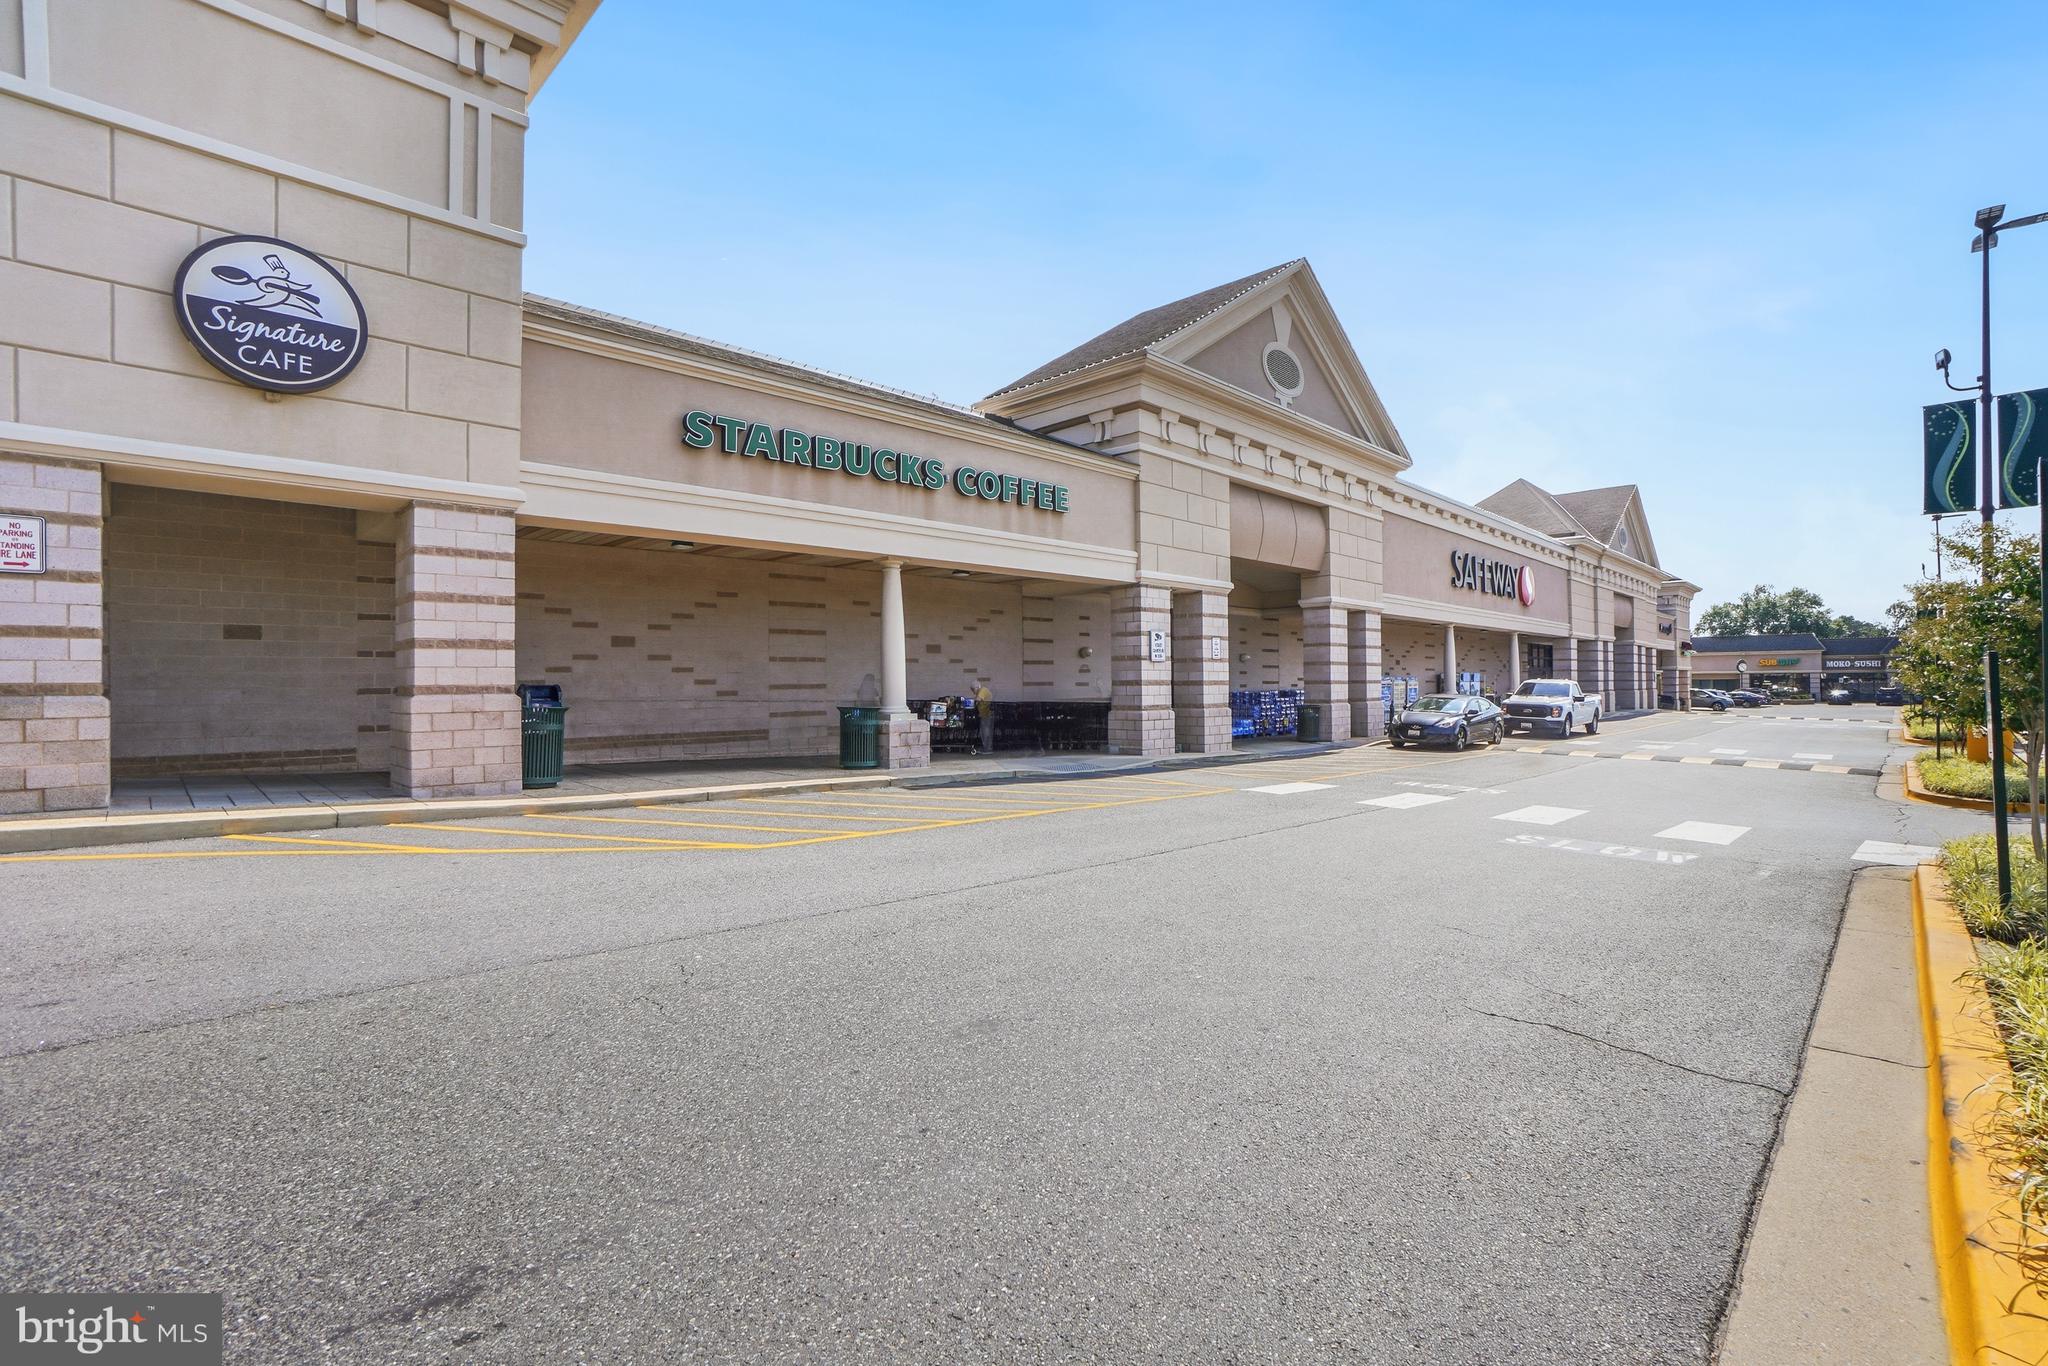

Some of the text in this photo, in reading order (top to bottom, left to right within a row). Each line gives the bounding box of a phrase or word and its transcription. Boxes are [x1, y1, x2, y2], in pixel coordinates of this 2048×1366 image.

[204, 305, 345, 353] Signature
[238, 345, 313, 375] CAFE
[682, 410, 1069, 513] STARBUCKS COFFEE
[0, 542, 36, 550] TANDING
[0, 549, 37, 559] RE LANE
[1451, 549, 1519, 600] SAFEWAY
